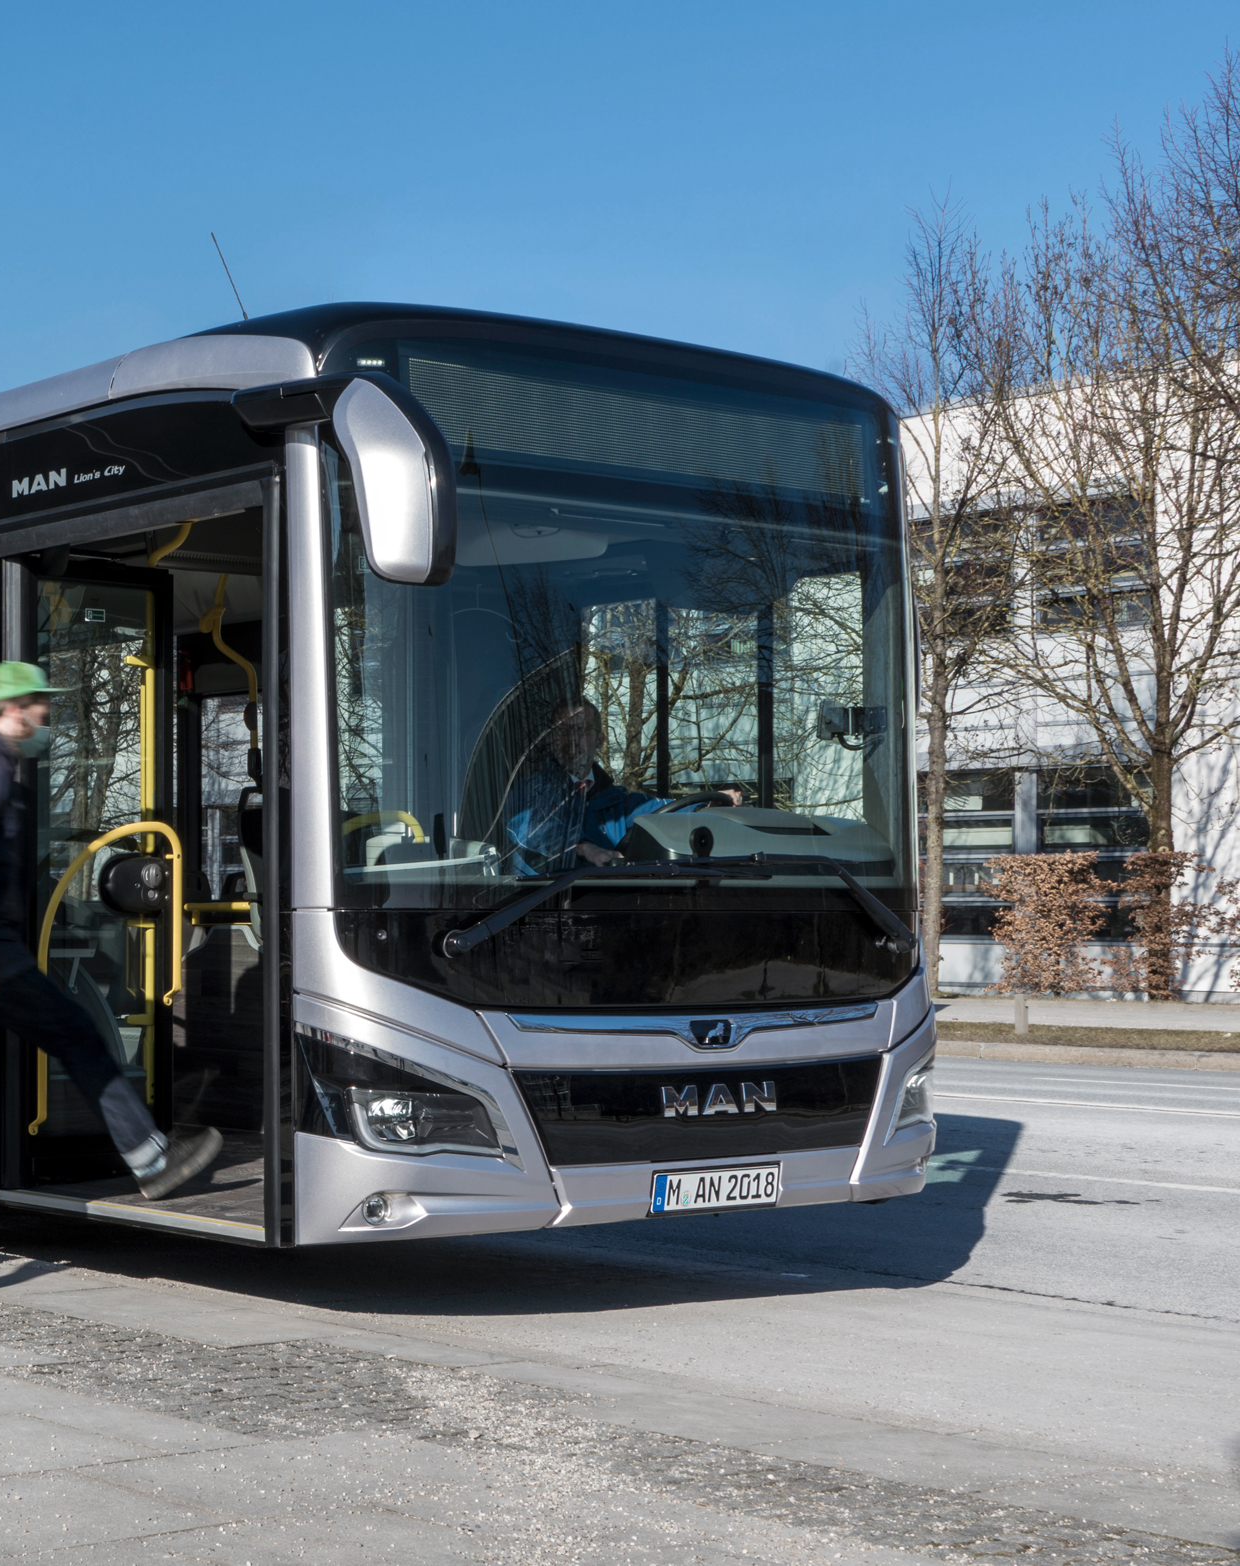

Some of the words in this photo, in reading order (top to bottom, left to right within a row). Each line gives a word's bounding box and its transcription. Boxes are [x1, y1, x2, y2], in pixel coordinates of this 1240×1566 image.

[12, 467, 67, 498] MAN
[74, 469, 101, 483] Lion's
[104, 465, 126, 476] City
[661, 1081, 777, 1118] MAN
[656, 1197, 662, 1206] D
[667, 1178, 682, 1206] M
[693, 1175, 722, 1204] AN
[726, 1172, 775, 1201] 2018
